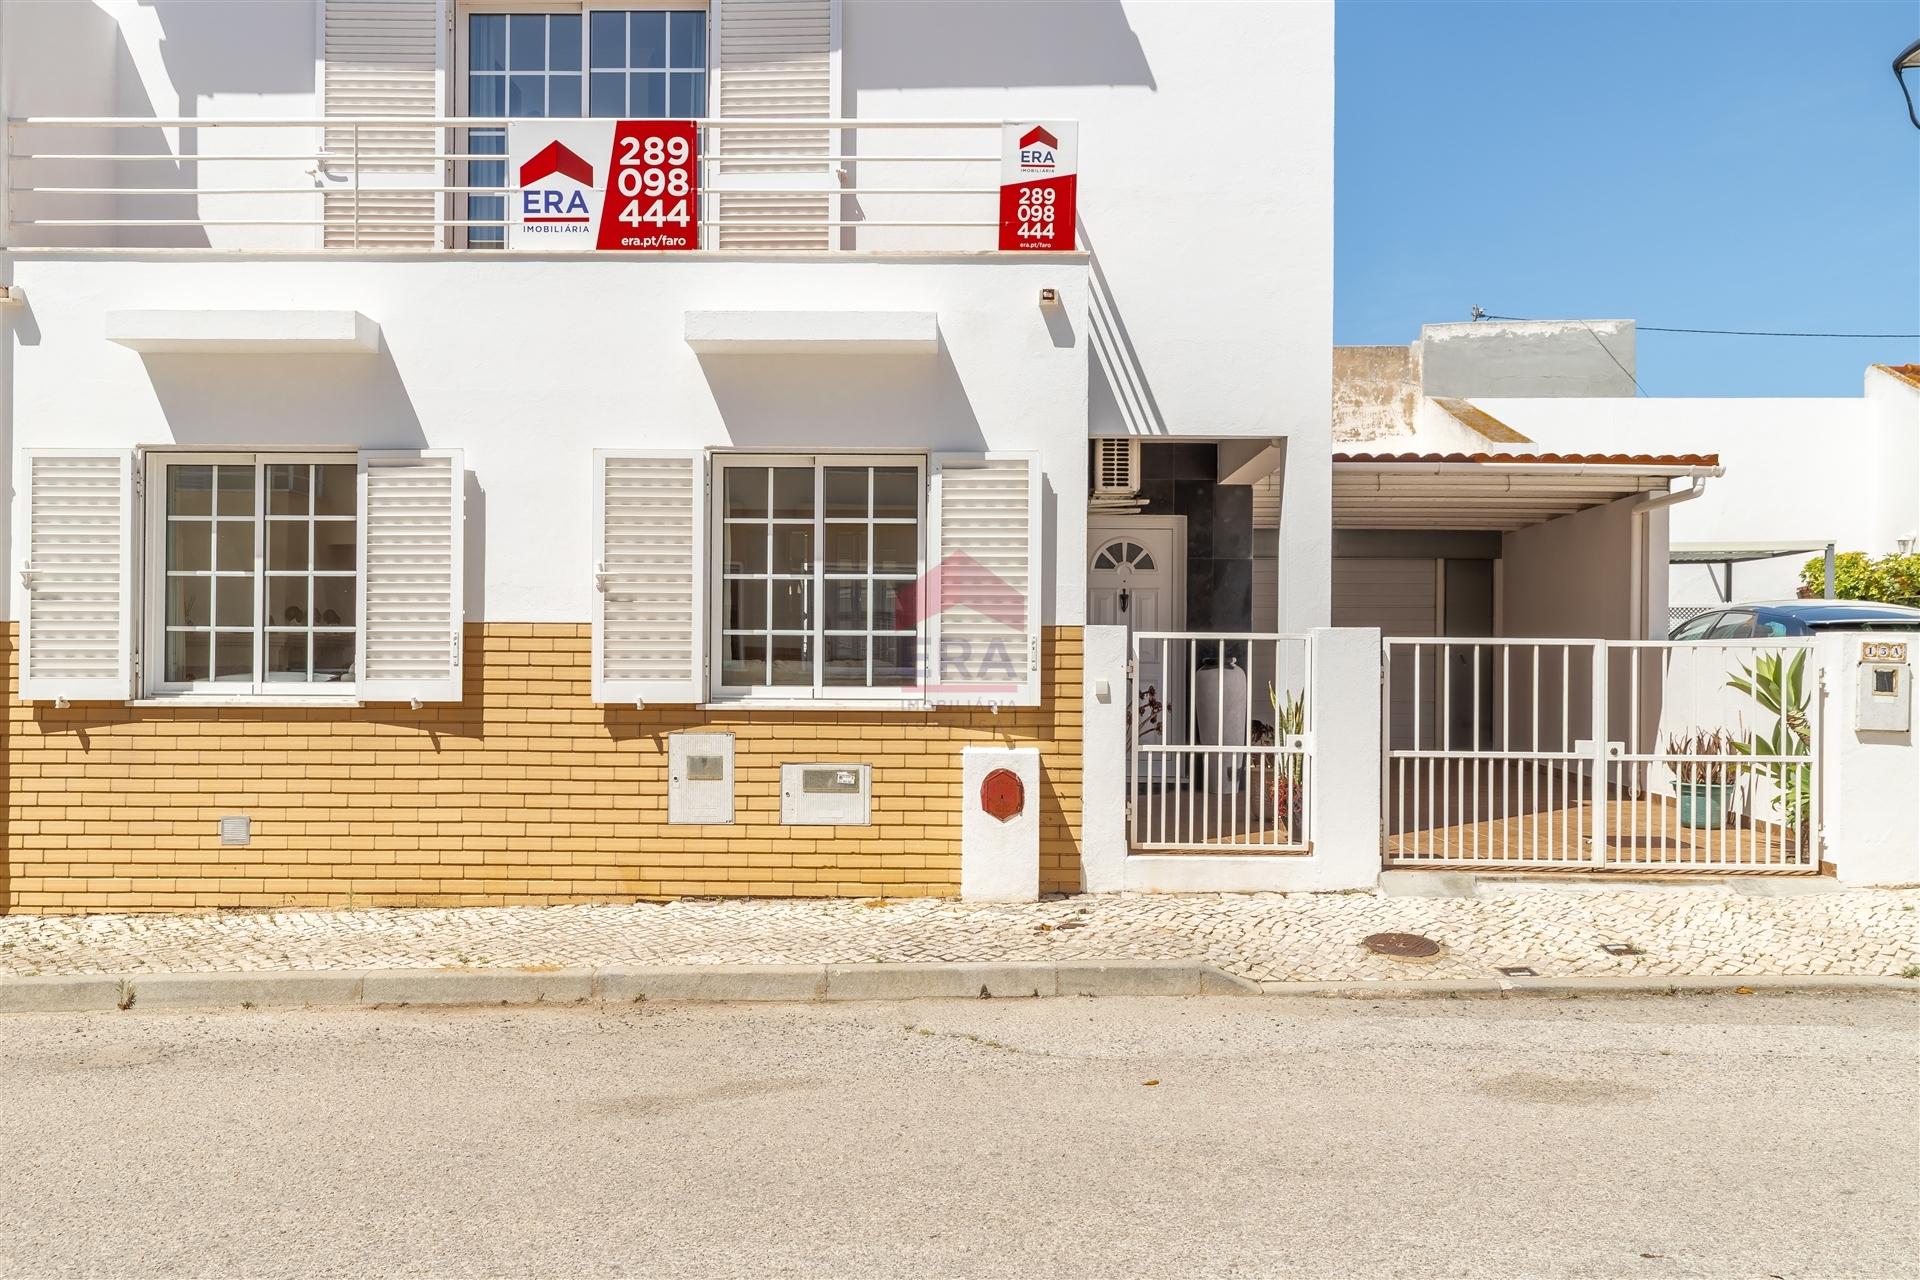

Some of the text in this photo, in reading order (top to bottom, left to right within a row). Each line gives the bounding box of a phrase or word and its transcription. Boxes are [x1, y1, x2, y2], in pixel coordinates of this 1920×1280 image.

[619, 136, 689, 166] 289
[1021, 150, 1055, 163] ERA
[618, 168, 689, 197] 098
[523, 190, 590, 214] ERA
[1018, 187, 1056, 205] 289
[618, 199, 691, 228] 444
[1017, 204, 1055, 222] 098
[523, 224, 590, 233] IMOBILIÁRIA
[1017, 222, 1055, 240] 444
[621, 234, 686, 247] era.pt/faro
